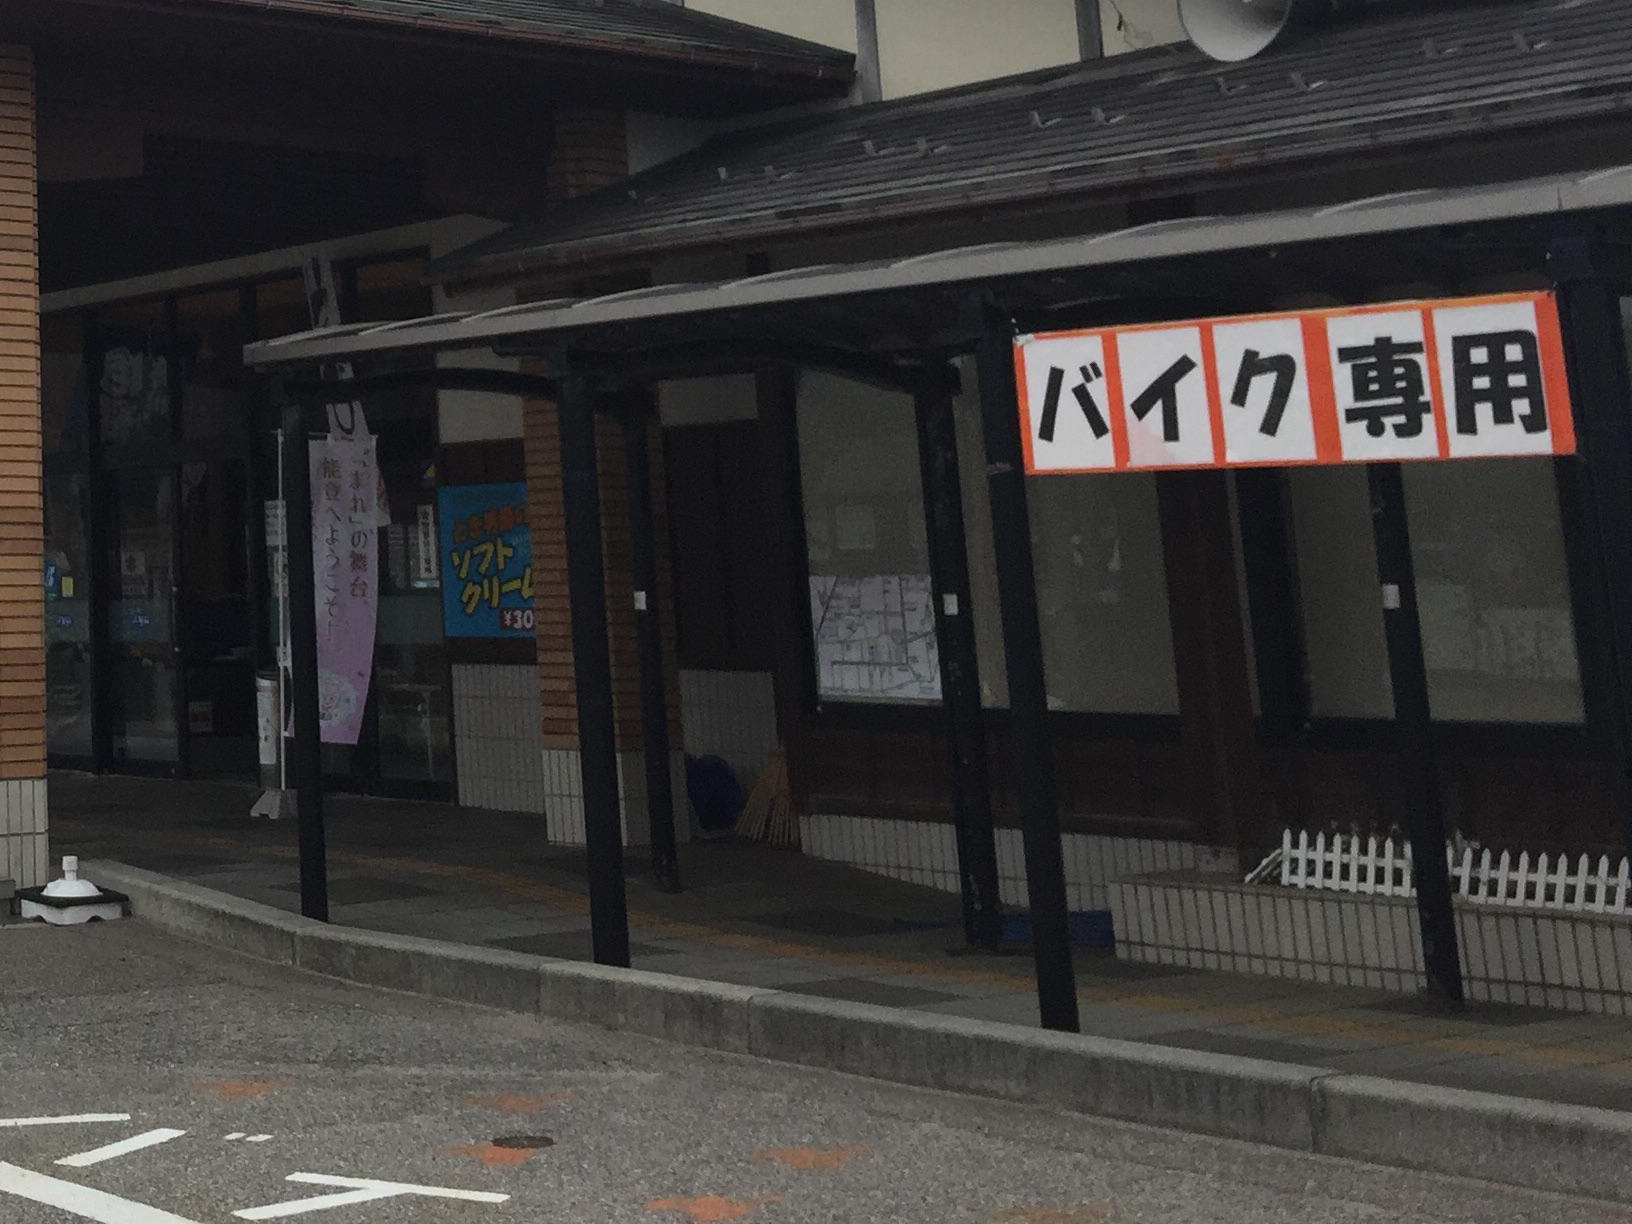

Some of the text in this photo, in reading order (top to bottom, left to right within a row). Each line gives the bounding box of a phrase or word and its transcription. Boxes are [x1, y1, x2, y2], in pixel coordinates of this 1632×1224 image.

[1038, 329, 1548, 443] バイク専用
[450, 537, 514, 580] ソフト
